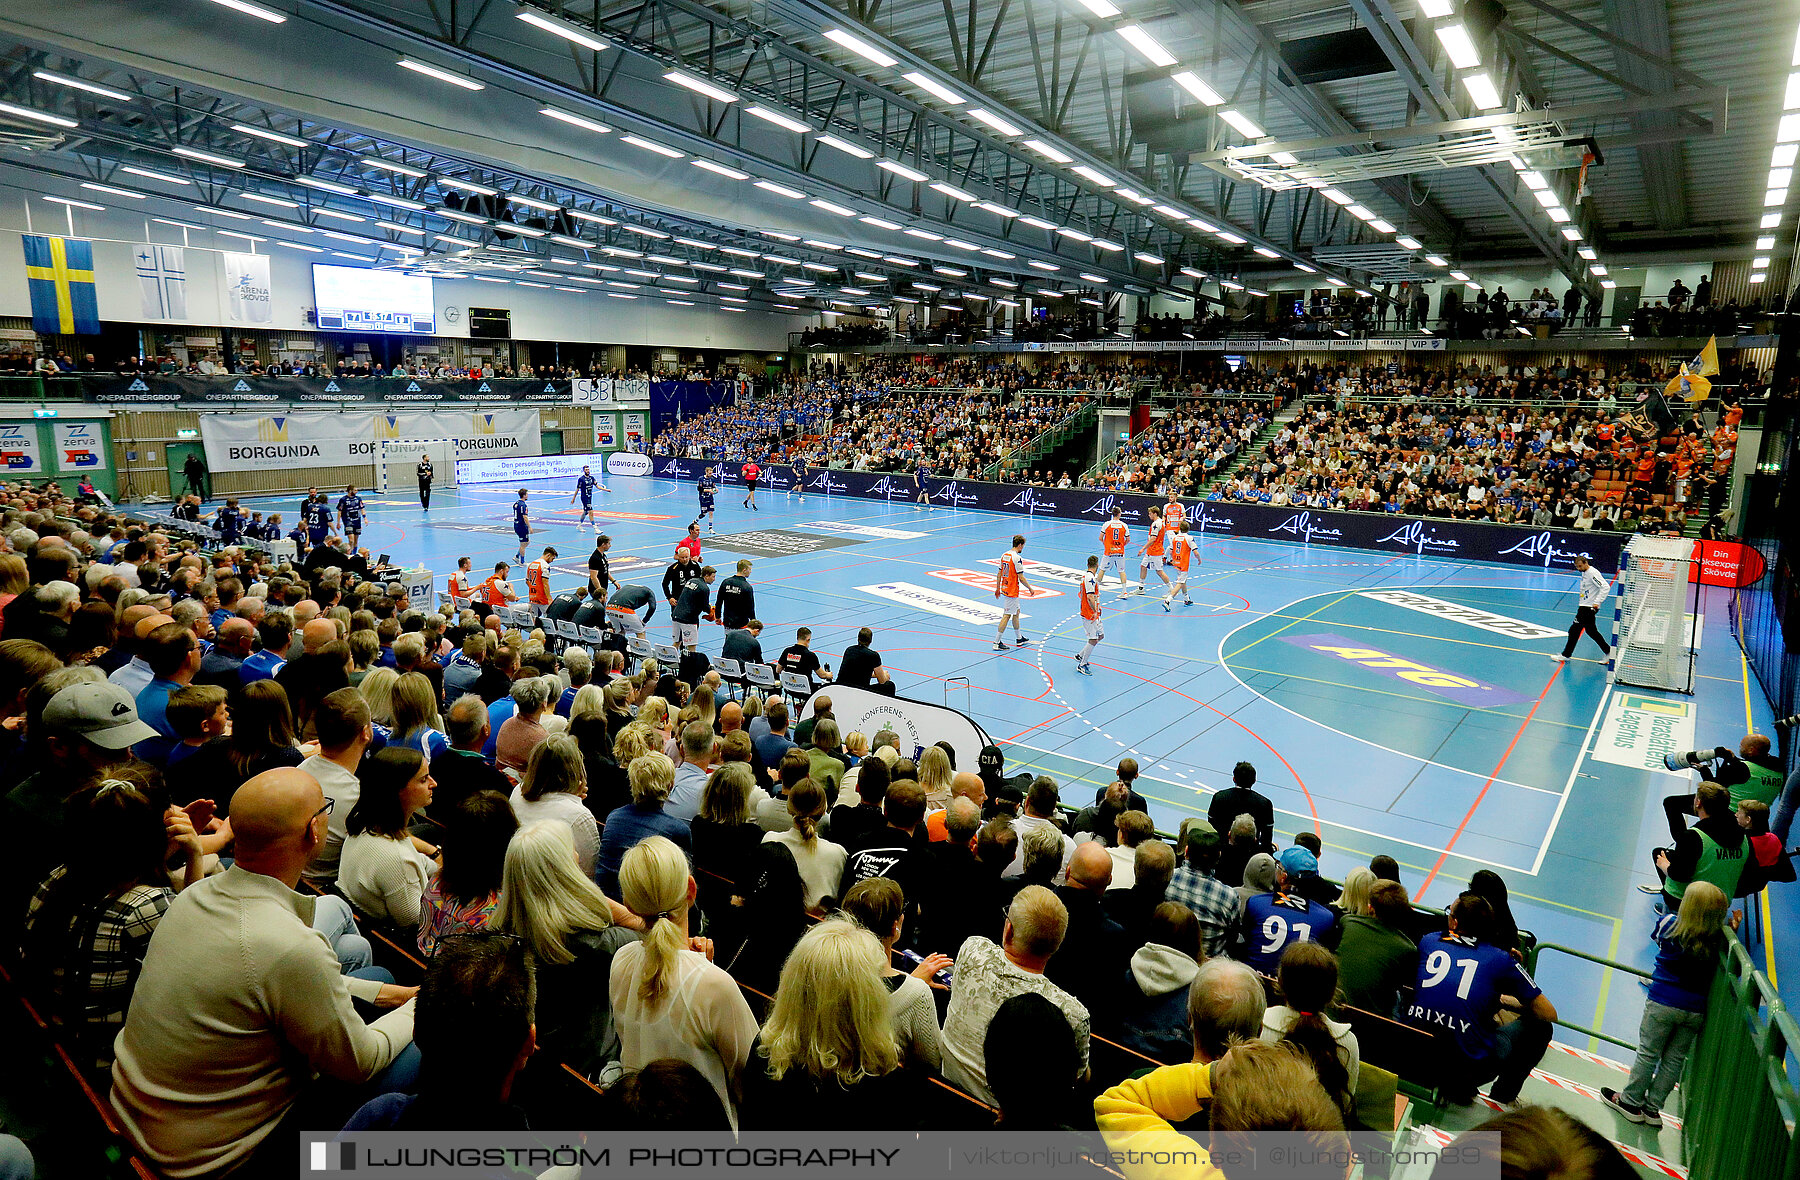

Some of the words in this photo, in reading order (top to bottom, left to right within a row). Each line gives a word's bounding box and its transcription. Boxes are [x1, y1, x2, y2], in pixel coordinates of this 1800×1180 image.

[240, 286, 269, 295] ARENA
[1412, 340, 1427, 349] VIP
[63, 438, 96, 447] zerva
[229, 445, 320, 459] BORGUNDA
[458, 437, 519, 451] ORGUNDA
[512, 467, 549, 476] Redovisning
[514, 461, 545, 469] personliga
[609, 460, 631, 468] LUDVIG
[660, 459, 691, 480] Alpina
[807, 471, 848, 495] Alpina
[865, 476, 910, 500] Alpina
[930, 481, 979, 506] Alpina
[1003, 488, 1057, 515] Alpina
[308, 513, 319, 524] 23
[1268, 511, 1343, 543] Alpina
[1376, 520, 1461, 554] Alpina
[1713, 550, 1729, 558] Din
[1703, 567, 1737, 579] Skövde
[1370, 592, 1552, 636] FRISTADS
[1309, 644, 1480, 688] ATG
[860, 705, 904, 723] KONFERENS
[905, 719, 920, 748] RESTA
[1613, 709, 1649, 750] Lagerhus
[981, 755, 998, 765] CIA
[851, 848, 908, 877] Tommy
[1261, 914, 1312, 954] 91
[1421, 950, 1479, 1000] 91
[1407, 1004, 1471, 1034] BRIXLY
